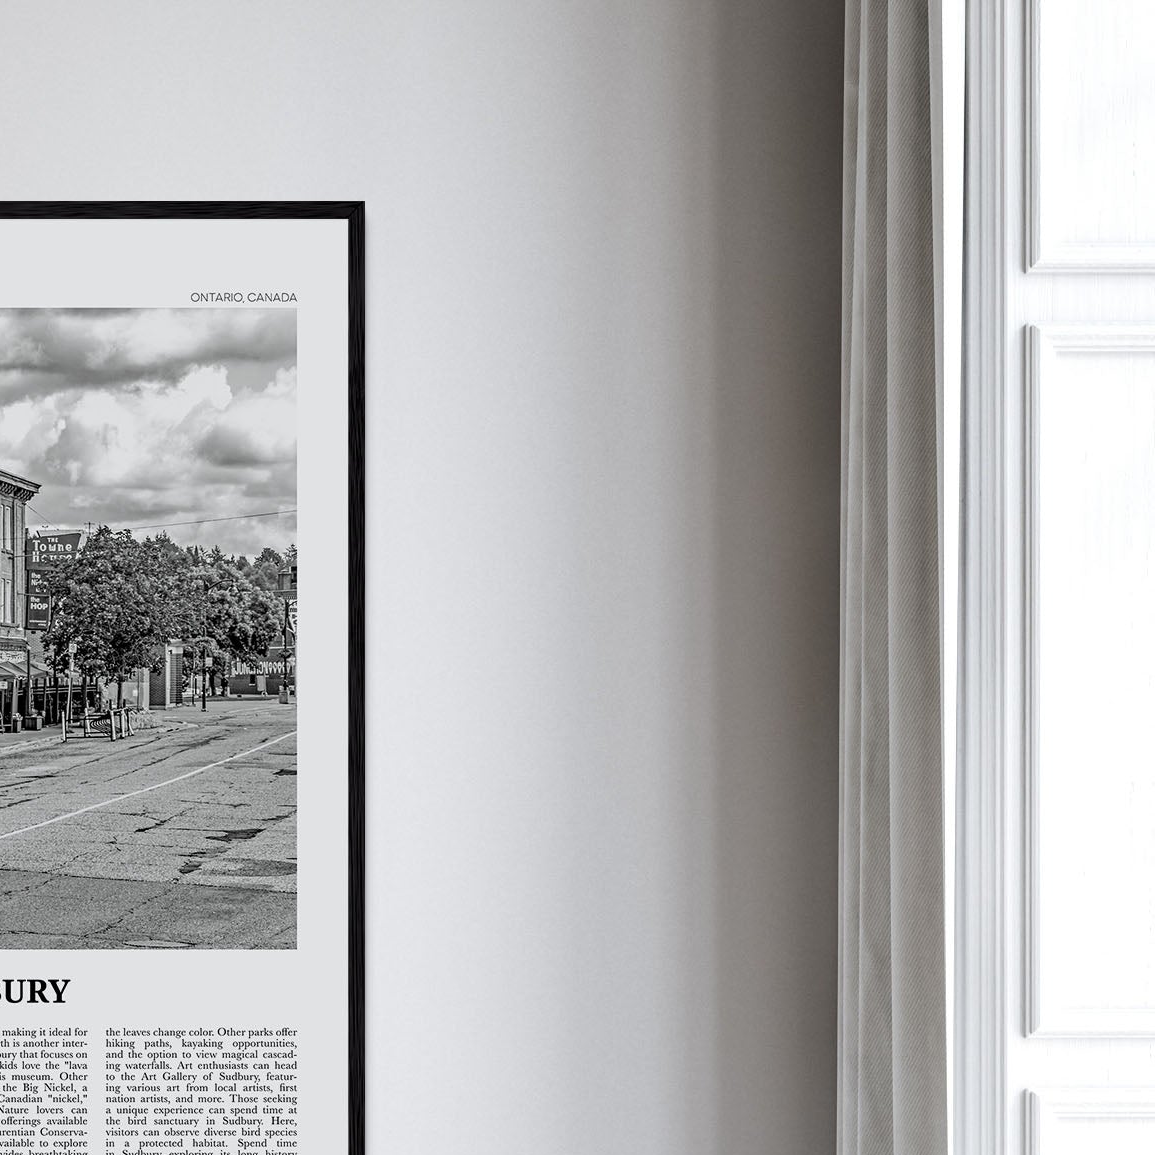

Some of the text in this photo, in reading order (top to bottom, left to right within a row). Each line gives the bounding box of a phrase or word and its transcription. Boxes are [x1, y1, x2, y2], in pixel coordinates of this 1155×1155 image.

[190, 292, 298, 303] ONTARIO, CANADA
[32, 540, 73, 552] Towne
[2, 1028, 37, 1038] making
[39, 1028, 46, 1036] it
[49, 1028, 71, 1036] ideal
[74, 1028, 88, 1036] for
[106, 1028, 298, 1038] the leaves change color. Other parks offer
[19, 1050, 38, 1058] that
[40, 1050, 74, 1058] focuses
[105, 1050, 297, 1060] and the option to view magical cascad-
[59, 1072, 88, 1080] Other
[106, 1072, 297, 1083] to the Art Gallery of Sudbury, featur-
[48, 1094, 88, 1104] "nickel,"
[106, 1094, 136, 1102] nation
[140, 1094, 171, 1104] artists,
[175, 1094, 193, 1102] and
[229, 1094, 258, 1102] Those
[263, 1094, 298, 1105] seeking
[0, 1117, 41, 1127] offerings
[46, 1117, 88, 1125] available
[106, 1117, 297, 1127] the bird sanctuary in Sudbury. Here,
[39, 1139, 49, 1147] to
[53, 1139, 88, 1149] explore
[106, 1139, 115, 1147] in
[139, 1139, 183, 1149] protected
[192, 1139, 228, 1147] habitat.
[237, 1139, 267, 1149] Spend
[276, 1139, 297, 1147] time
